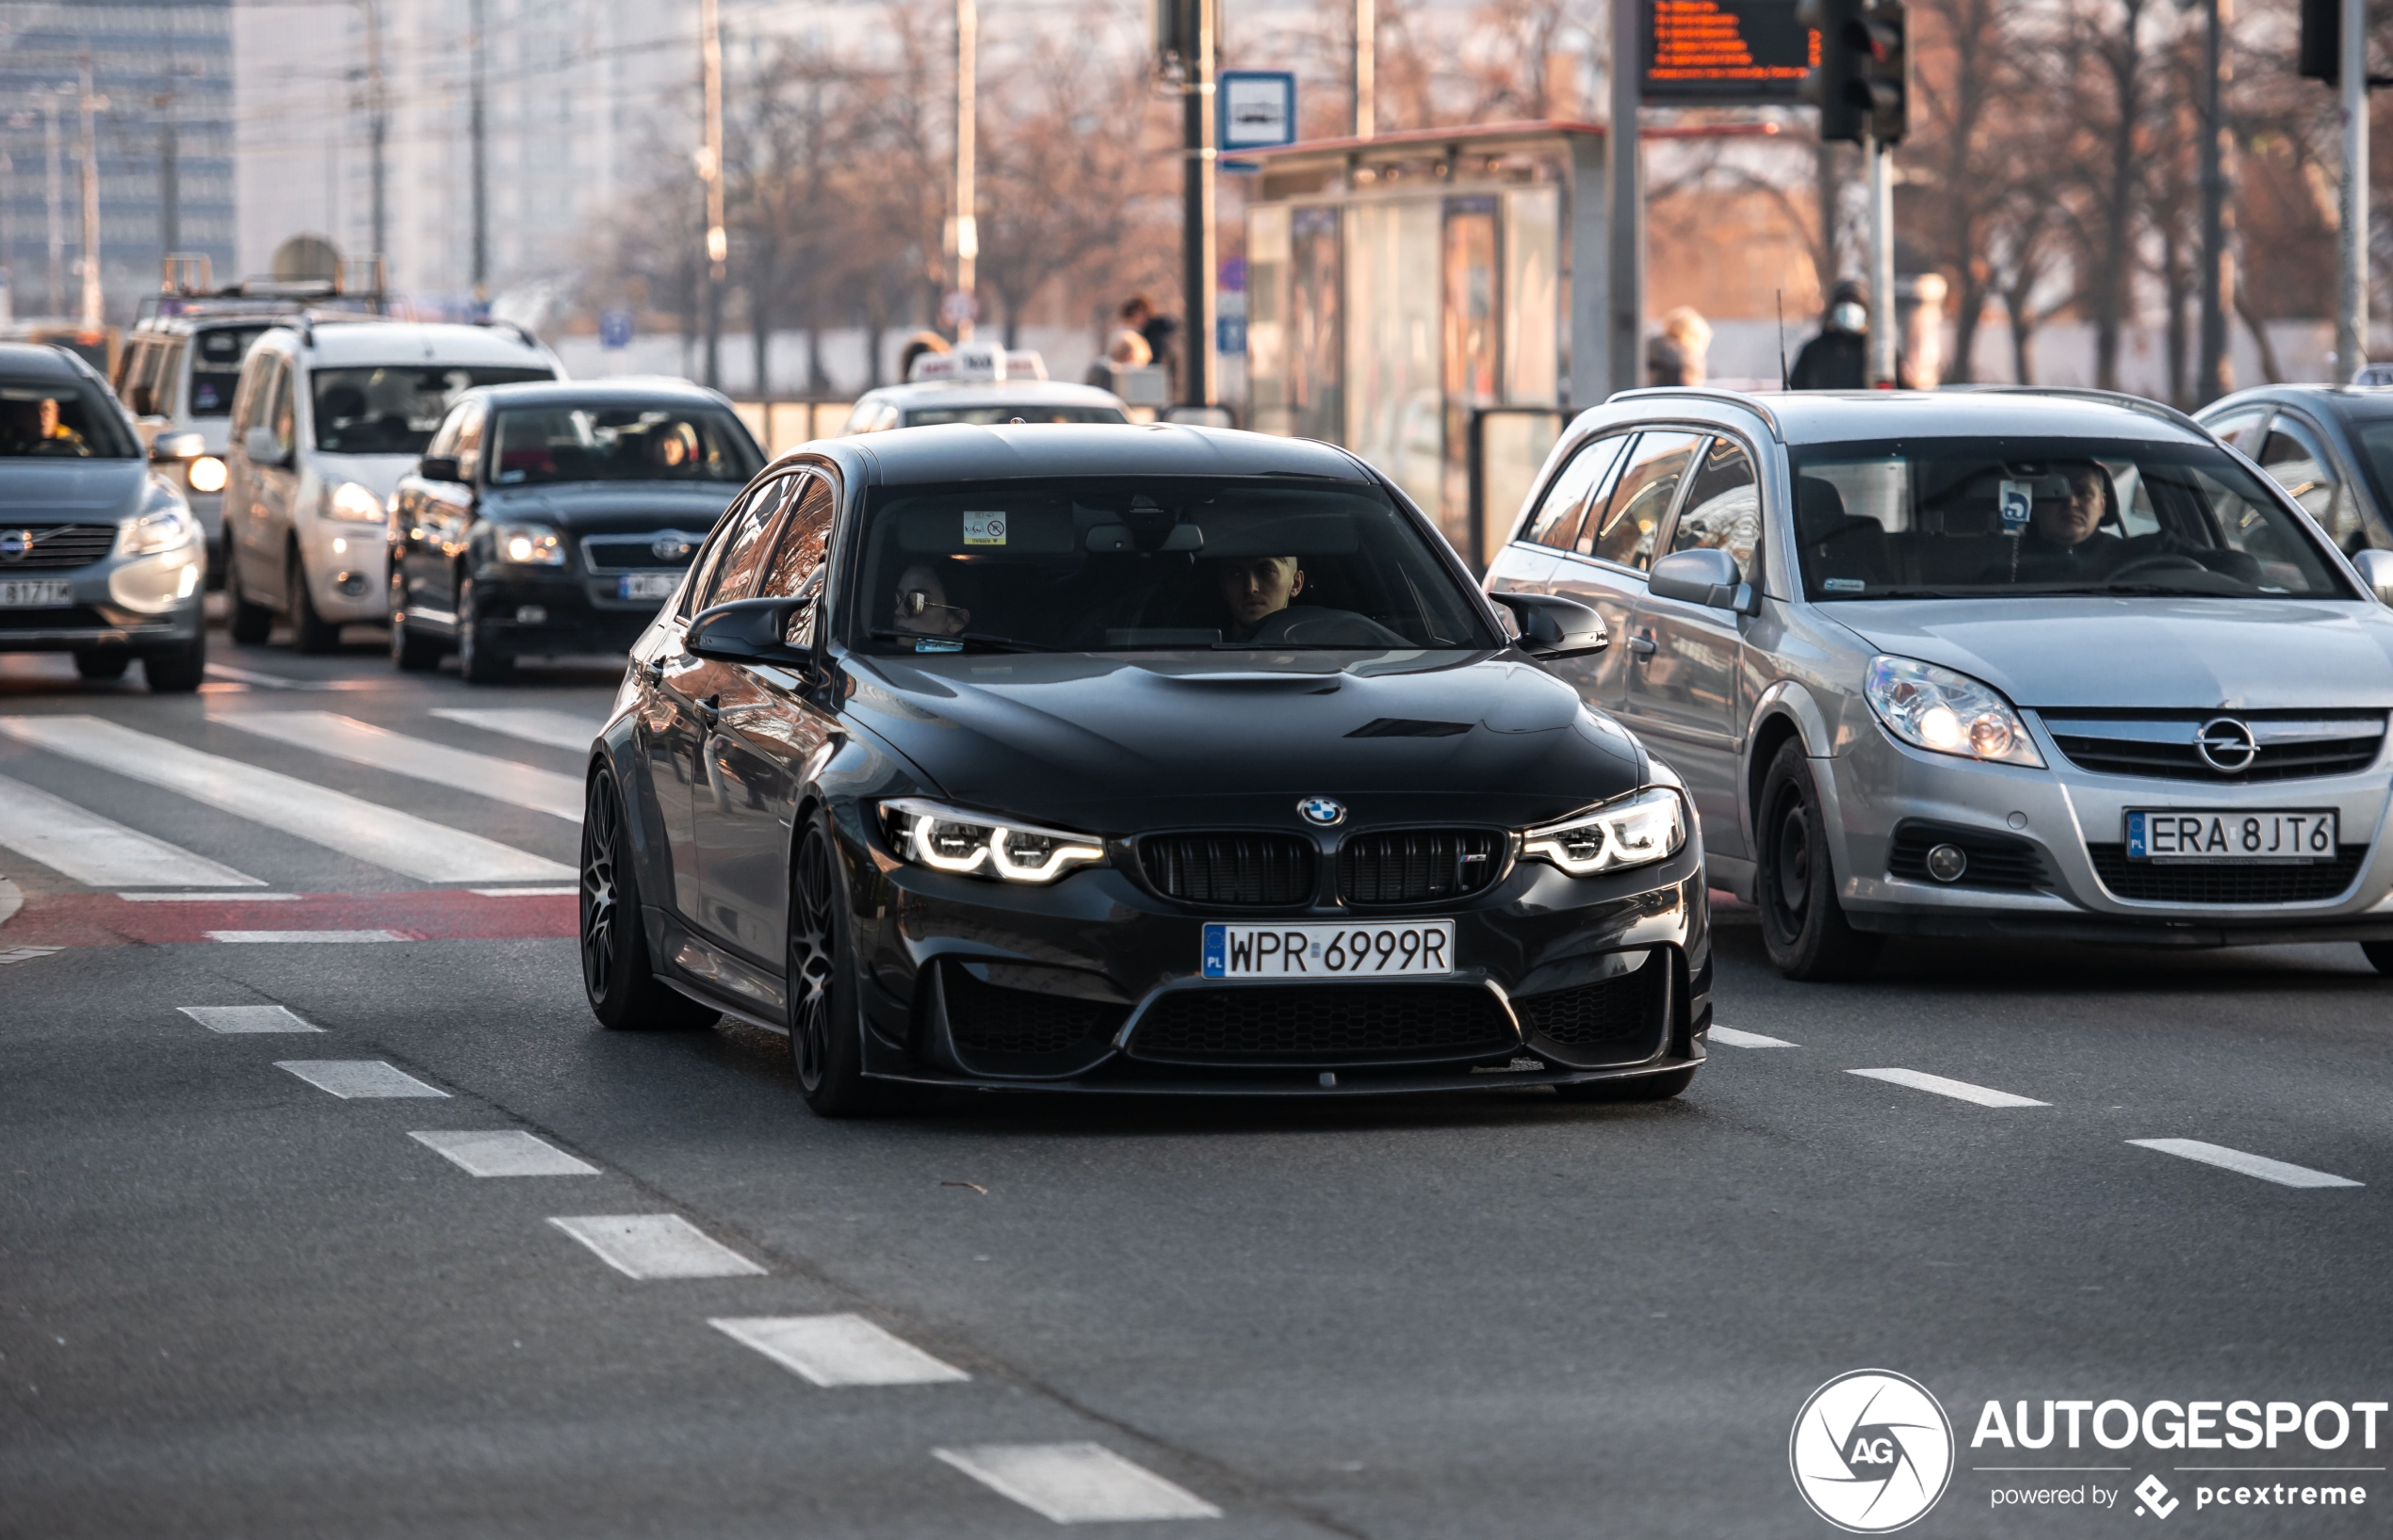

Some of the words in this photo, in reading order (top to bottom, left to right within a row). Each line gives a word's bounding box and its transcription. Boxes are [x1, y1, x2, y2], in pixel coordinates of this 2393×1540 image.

[2131, 838, 2144, 850] PL
[2152, 818, 2229, 851] ERA
[2242, 818, 2329, 851] 8JT6
[1229, 932, 1309, 972] WPR
[1324, 928, 1447, 971] 6999R
[1207, 957, 1222, 968] PL
